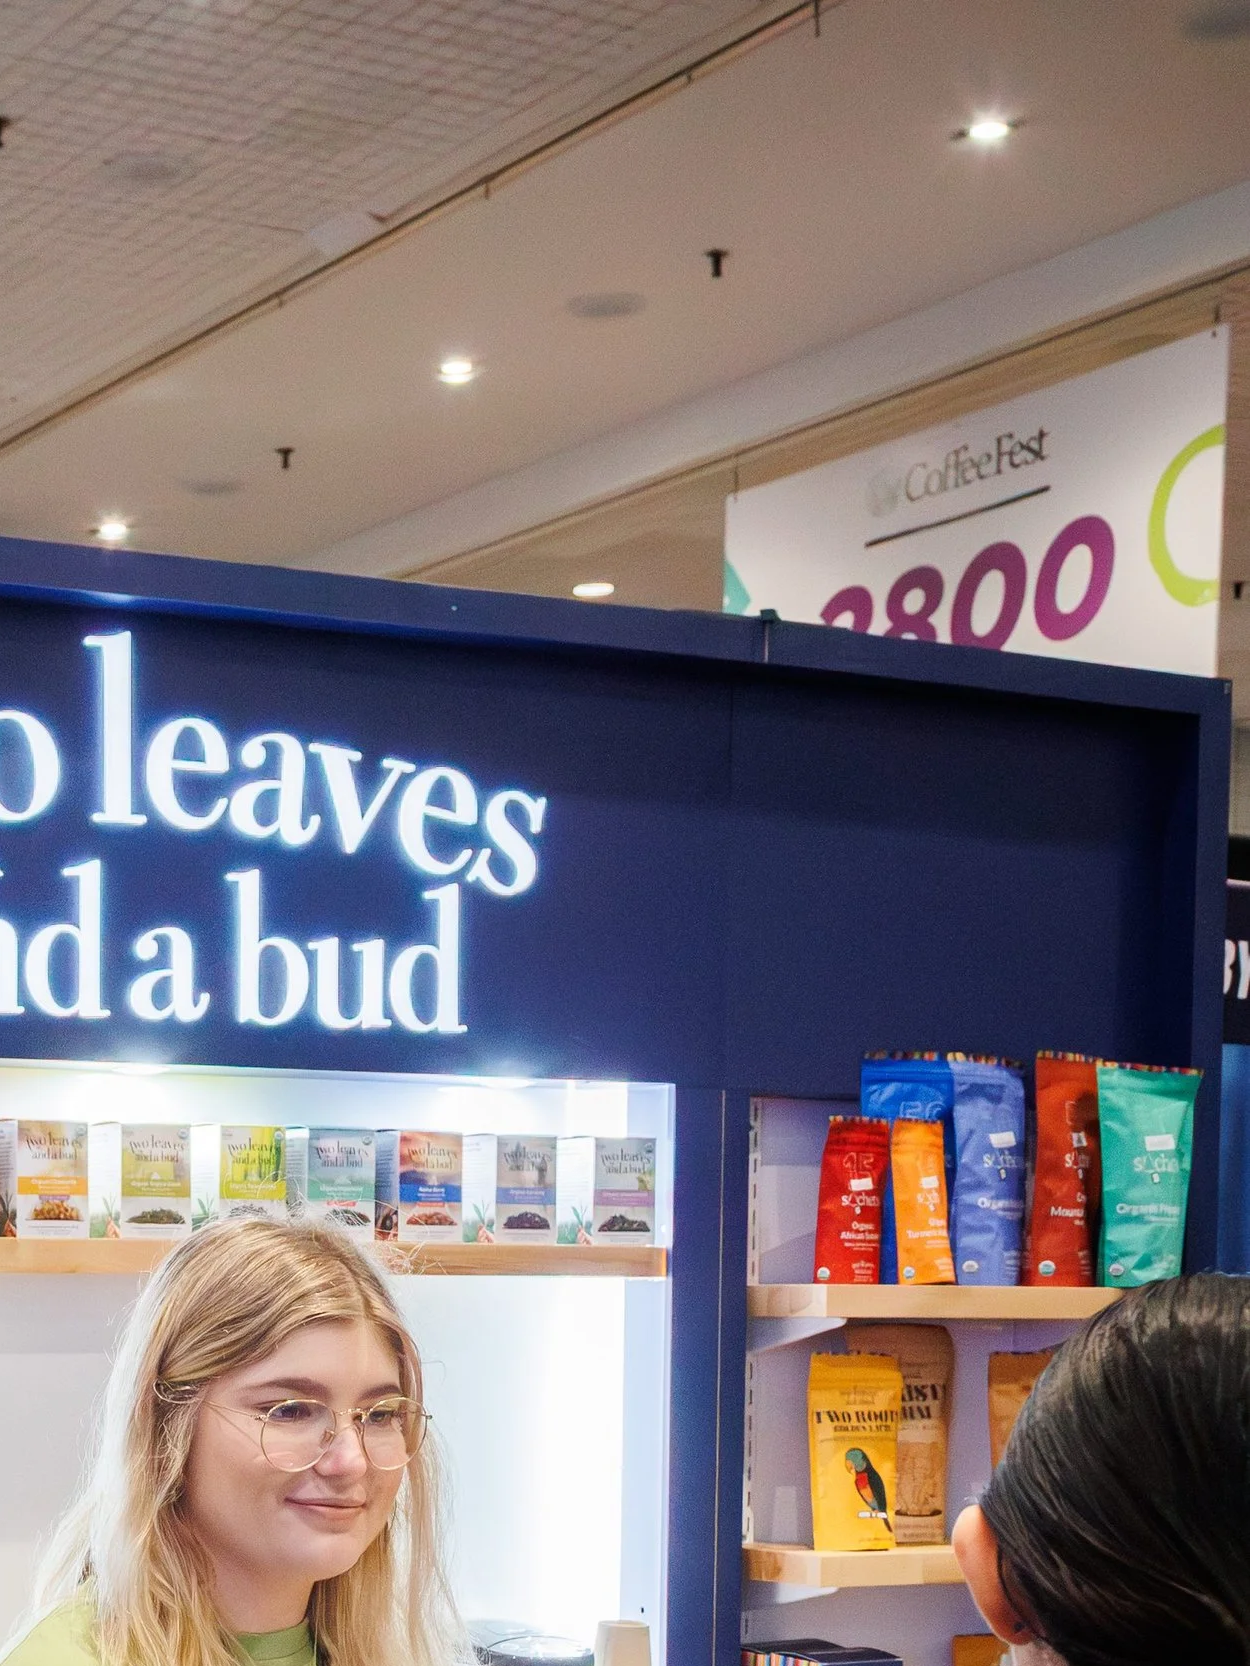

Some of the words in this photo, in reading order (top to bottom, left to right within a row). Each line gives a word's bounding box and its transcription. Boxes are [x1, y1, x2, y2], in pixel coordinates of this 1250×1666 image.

[83, 631, 546, 896] leaves
[129, 926, 211, 1022] a
[227, 870, 467, 1033] bud
